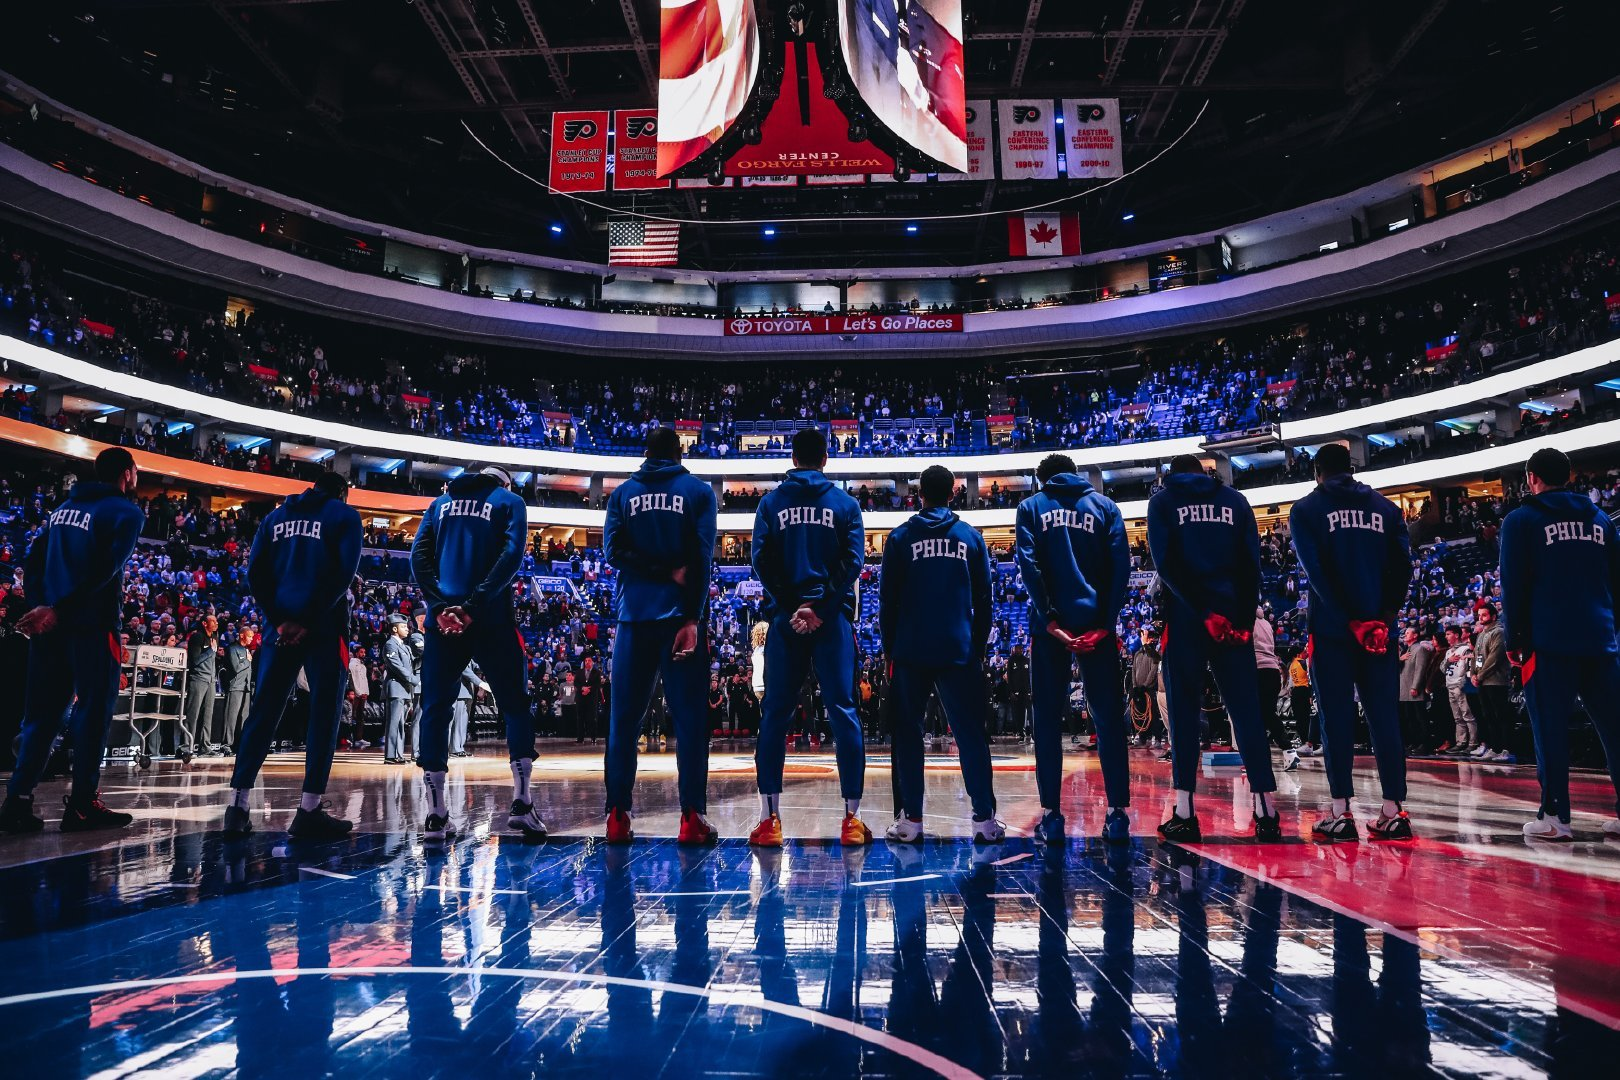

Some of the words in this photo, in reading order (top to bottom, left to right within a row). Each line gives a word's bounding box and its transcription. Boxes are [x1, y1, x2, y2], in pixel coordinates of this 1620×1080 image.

[737, 160, 806, 169] FARGO
[778, 152, 840, 160] CENTER
[810, 159, 883, 167] WELLS
[1157, 260, 1188, 270] RIVERS
[756, 320, 812, 333] TOYOTA
[843, 317, 877, 331] Let's
[881, 317, 901, 330] Go
[905, 316, 953, 329] Places
[438, 499, 492, 522] PHILA
[630, 492, 684, 517] PHILA
[1177, 503, 1234, 526] PHILA
[49, 508, 91, 531] PHILA
[777, 506, 835, 531] PHILA
[1041, 508, 1095, 534] PHILA
[1326, 509, 1384, 534] PHILA
[272, 519, 322, 543] PHILA
[1545, 521, 1606, 545] PHILA
[911, 538, 968, 562] PHILA
